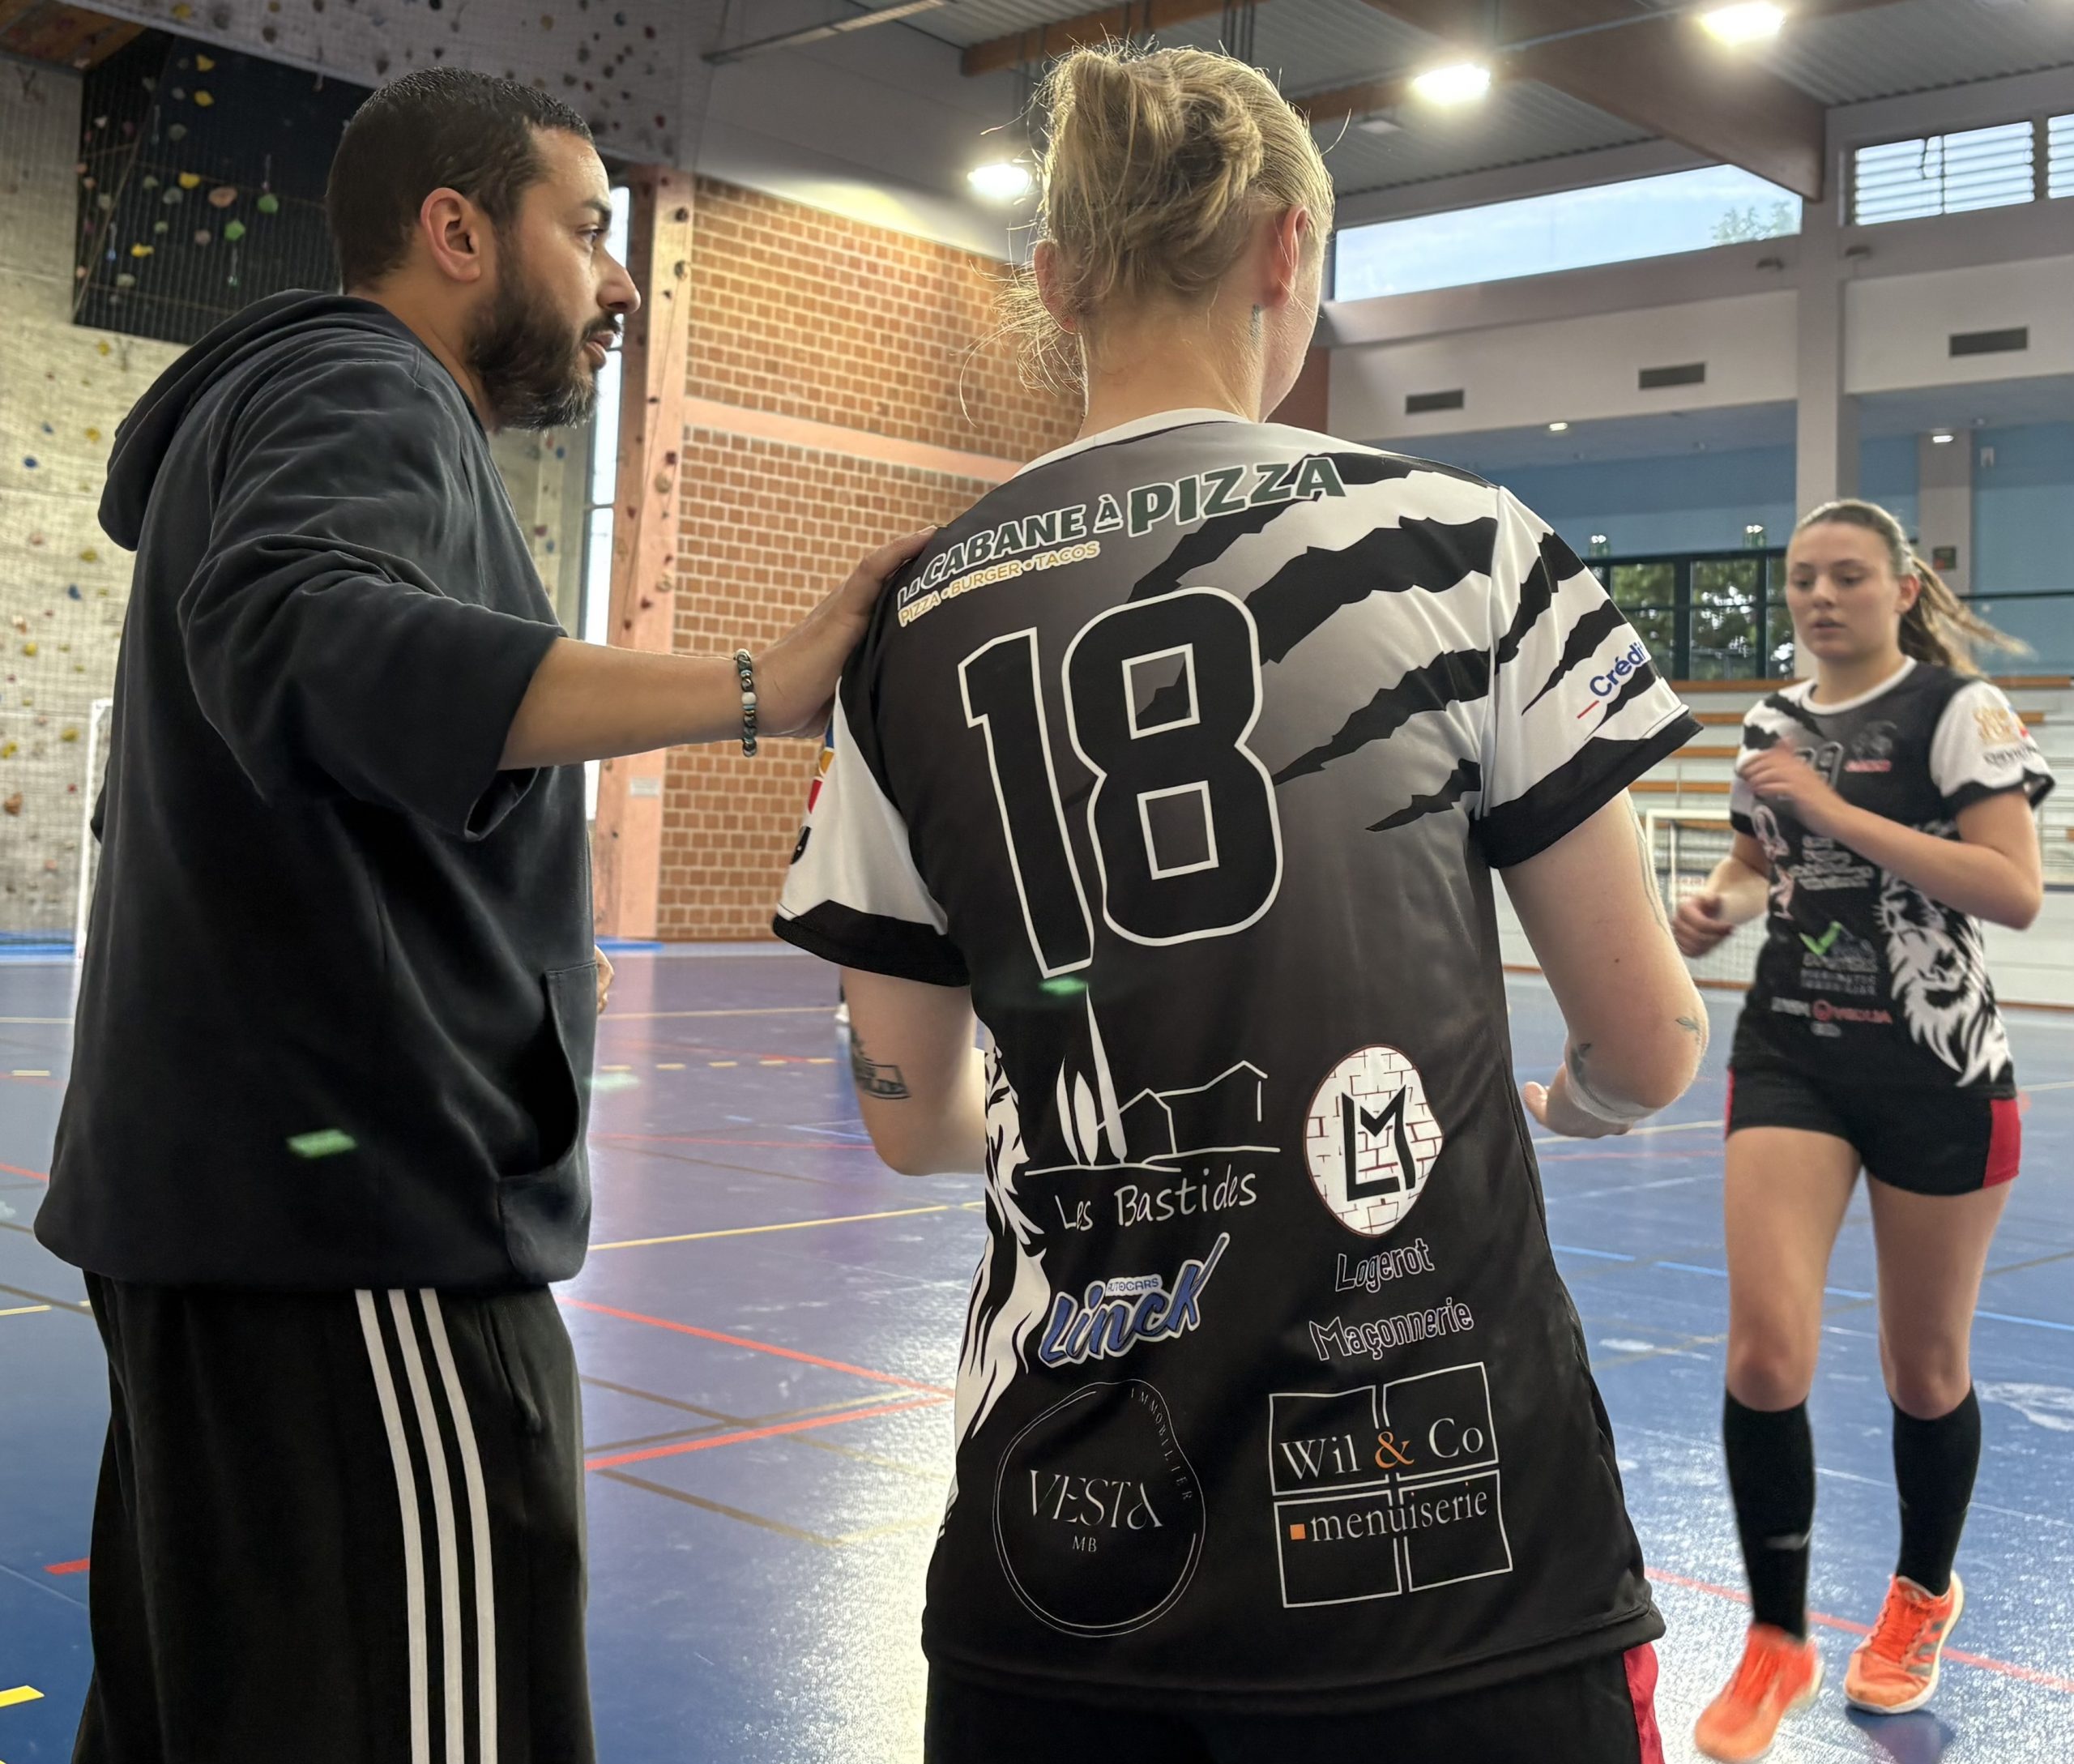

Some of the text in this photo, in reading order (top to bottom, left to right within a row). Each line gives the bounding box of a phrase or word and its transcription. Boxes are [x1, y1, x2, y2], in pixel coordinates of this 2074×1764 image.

[920, 502, 1088, 591] CABANE
[1093, 493, 1124, 535] À
[1127, 456, 1346, 538] PIZZA
[898, 540, 1100, 628] PIZZA BURGER TACOS
[958, 586, 1284, 979] 18
[1055, 1164, 1257, 1231] Les Bastides
[1334, 1237, 1436, 1294] Logerot
[1308, 1296, 1474, 1362] Maçonnerie
[1279, 1417, 1484, 1480] Wil & Co
[1029, 1469, 1164, 1531] VESTA
[1310, 1480, 1488, 1542] menuiserie
[1072, 1535, 1098, 1553] MB
